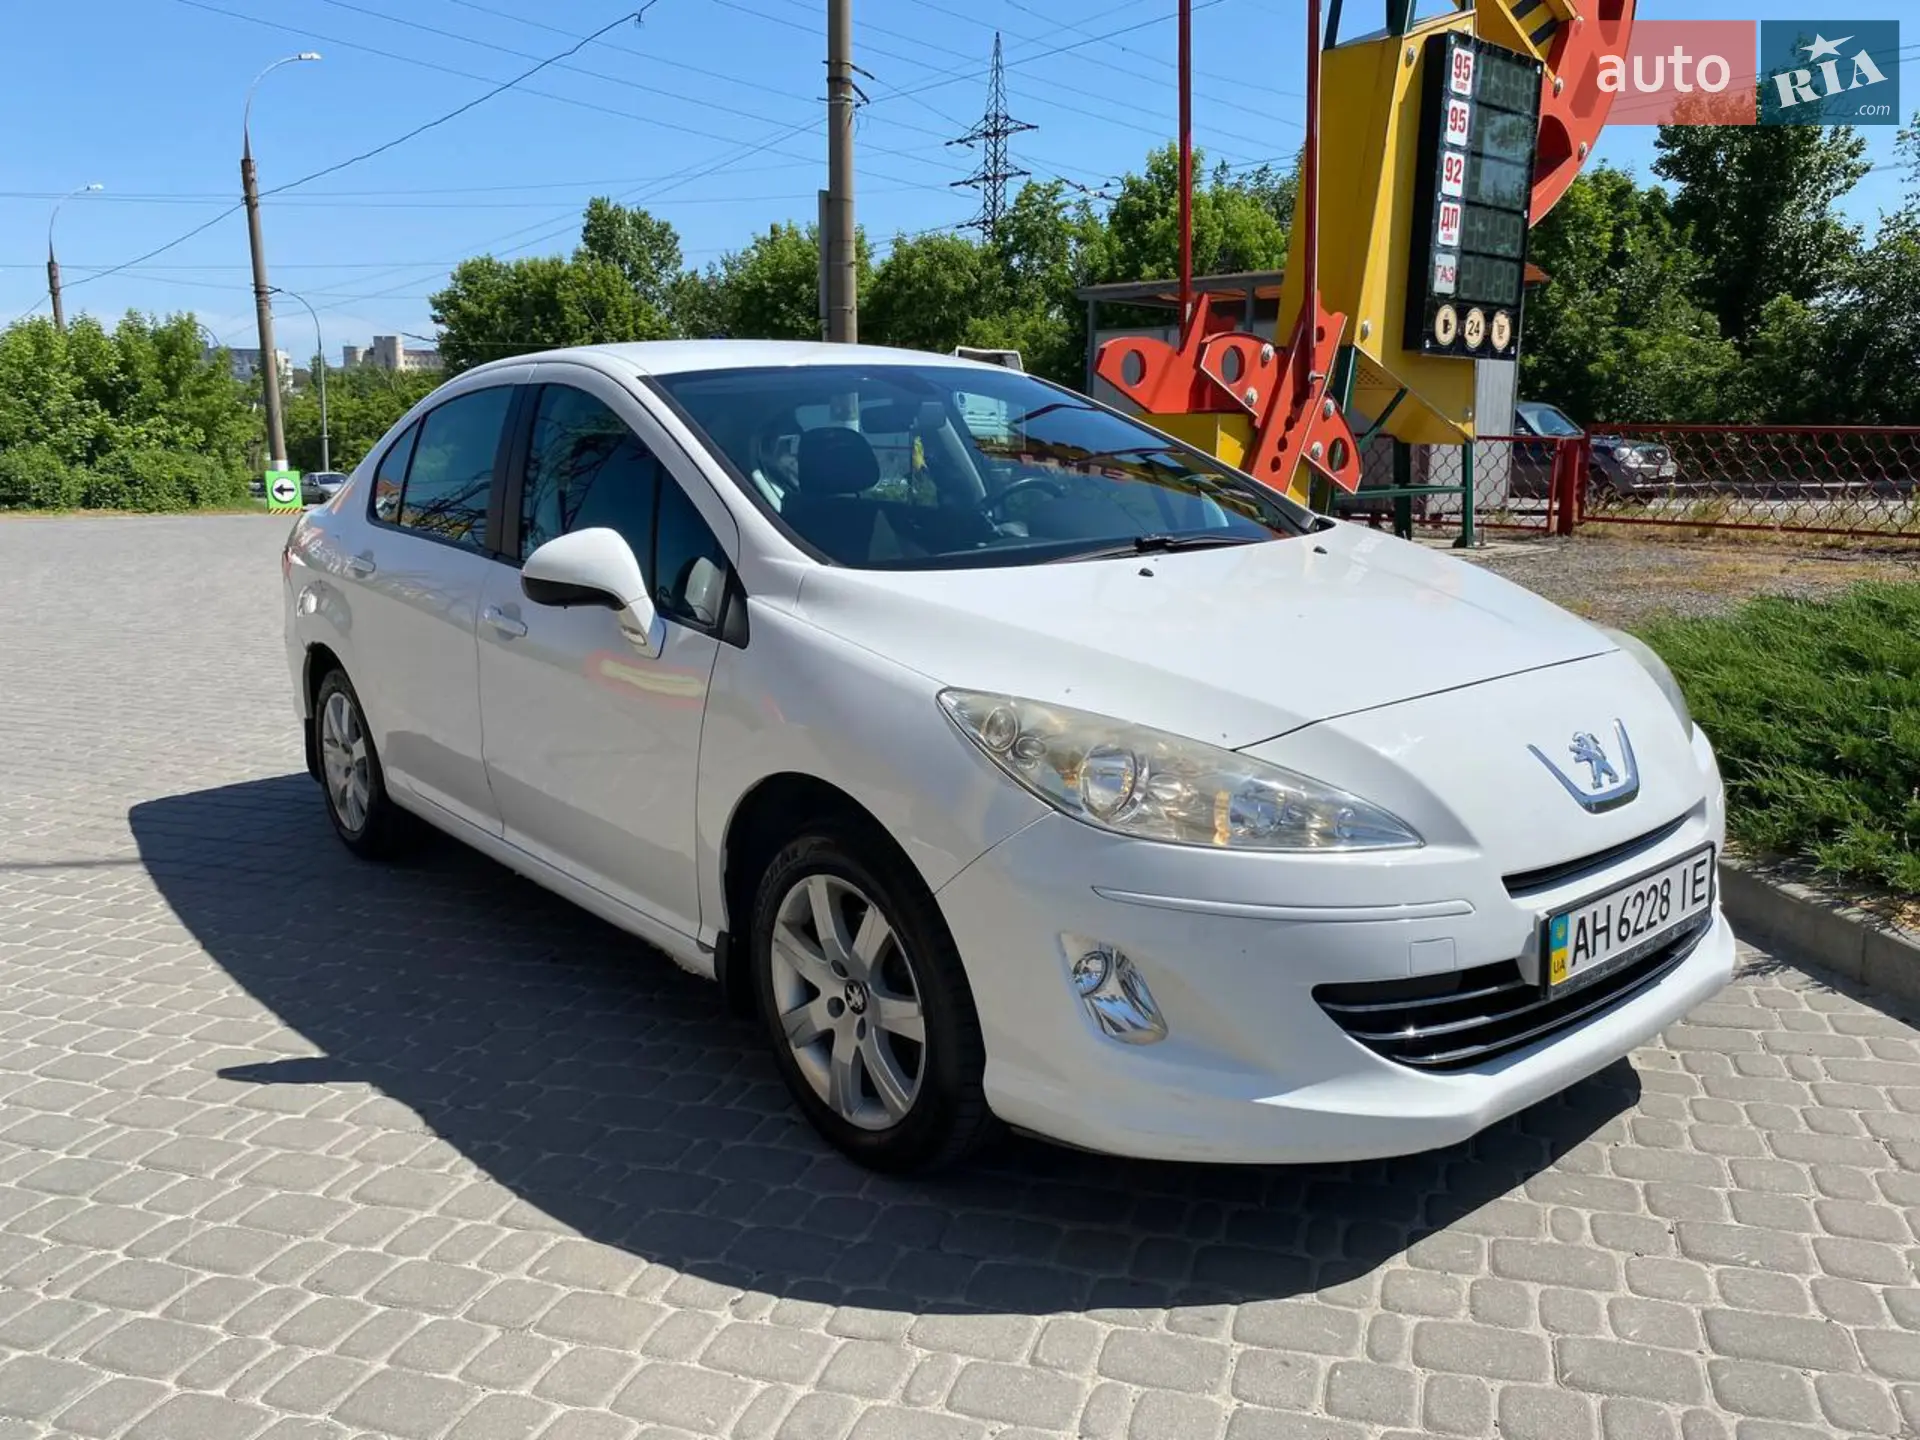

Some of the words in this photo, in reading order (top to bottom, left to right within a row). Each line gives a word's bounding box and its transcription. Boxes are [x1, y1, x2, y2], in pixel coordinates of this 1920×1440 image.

[1454, 53, 1471, 81] 95
[1450, 106, 1467, 133] 95
[1445, 156, 1462, 185] 92
[1441, 206, 1459, 232] ДП
[1468, 320, 1480, 336] 24
[1572, 906, 1610, 966] AH
[1618, 878, 1670, 942] 6228
[1682, 859, 1707, 911] IE
[1553, 959, 1565, 974] UA
